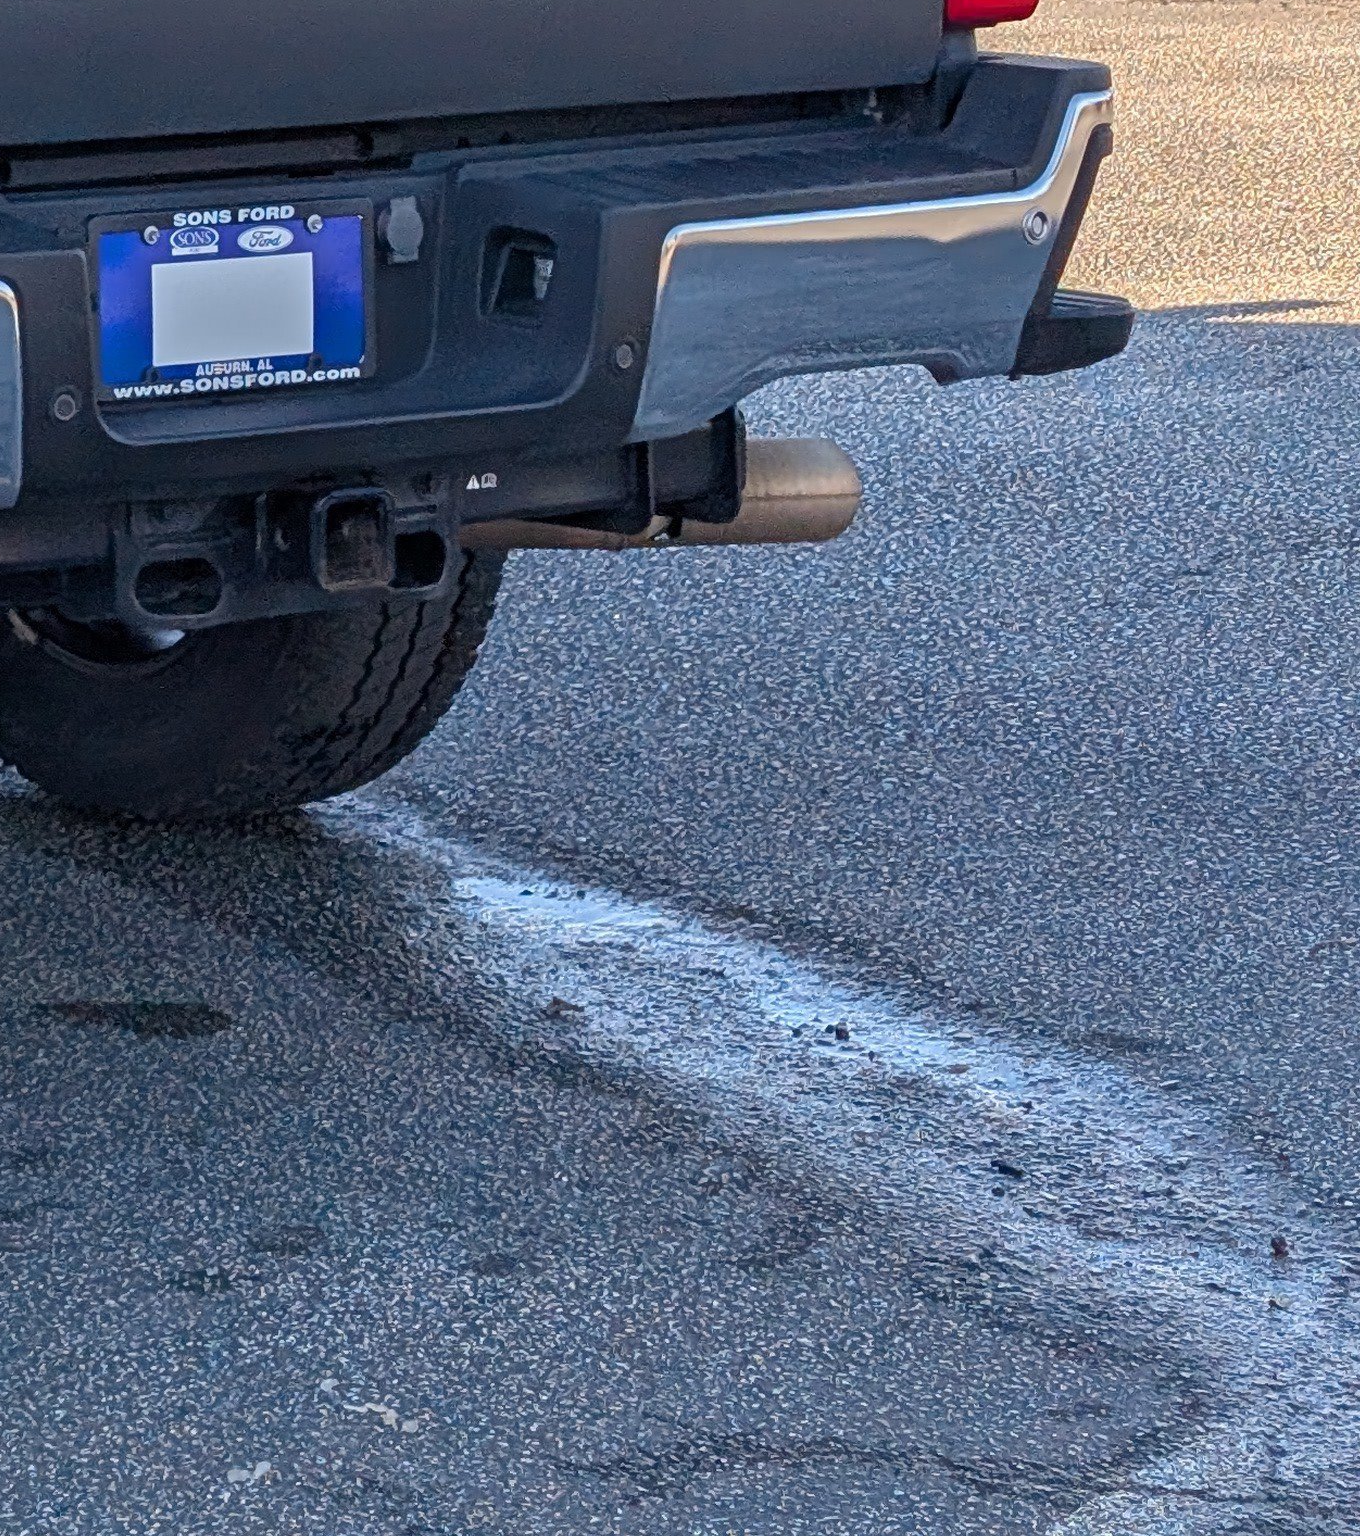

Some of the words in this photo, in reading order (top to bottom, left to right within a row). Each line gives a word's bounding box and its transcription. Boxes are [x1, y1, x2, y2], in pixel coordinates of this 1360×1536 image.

[173, 209, 232, 227] SONS
[237, 205, 295, 223] FORD
[177, 230, 212, 246] SONS
[248, 230, 283, 248] Ford
[257, 358, 274, 371] AL
[113, 366, 360, 400] www.SONSFORD.com
